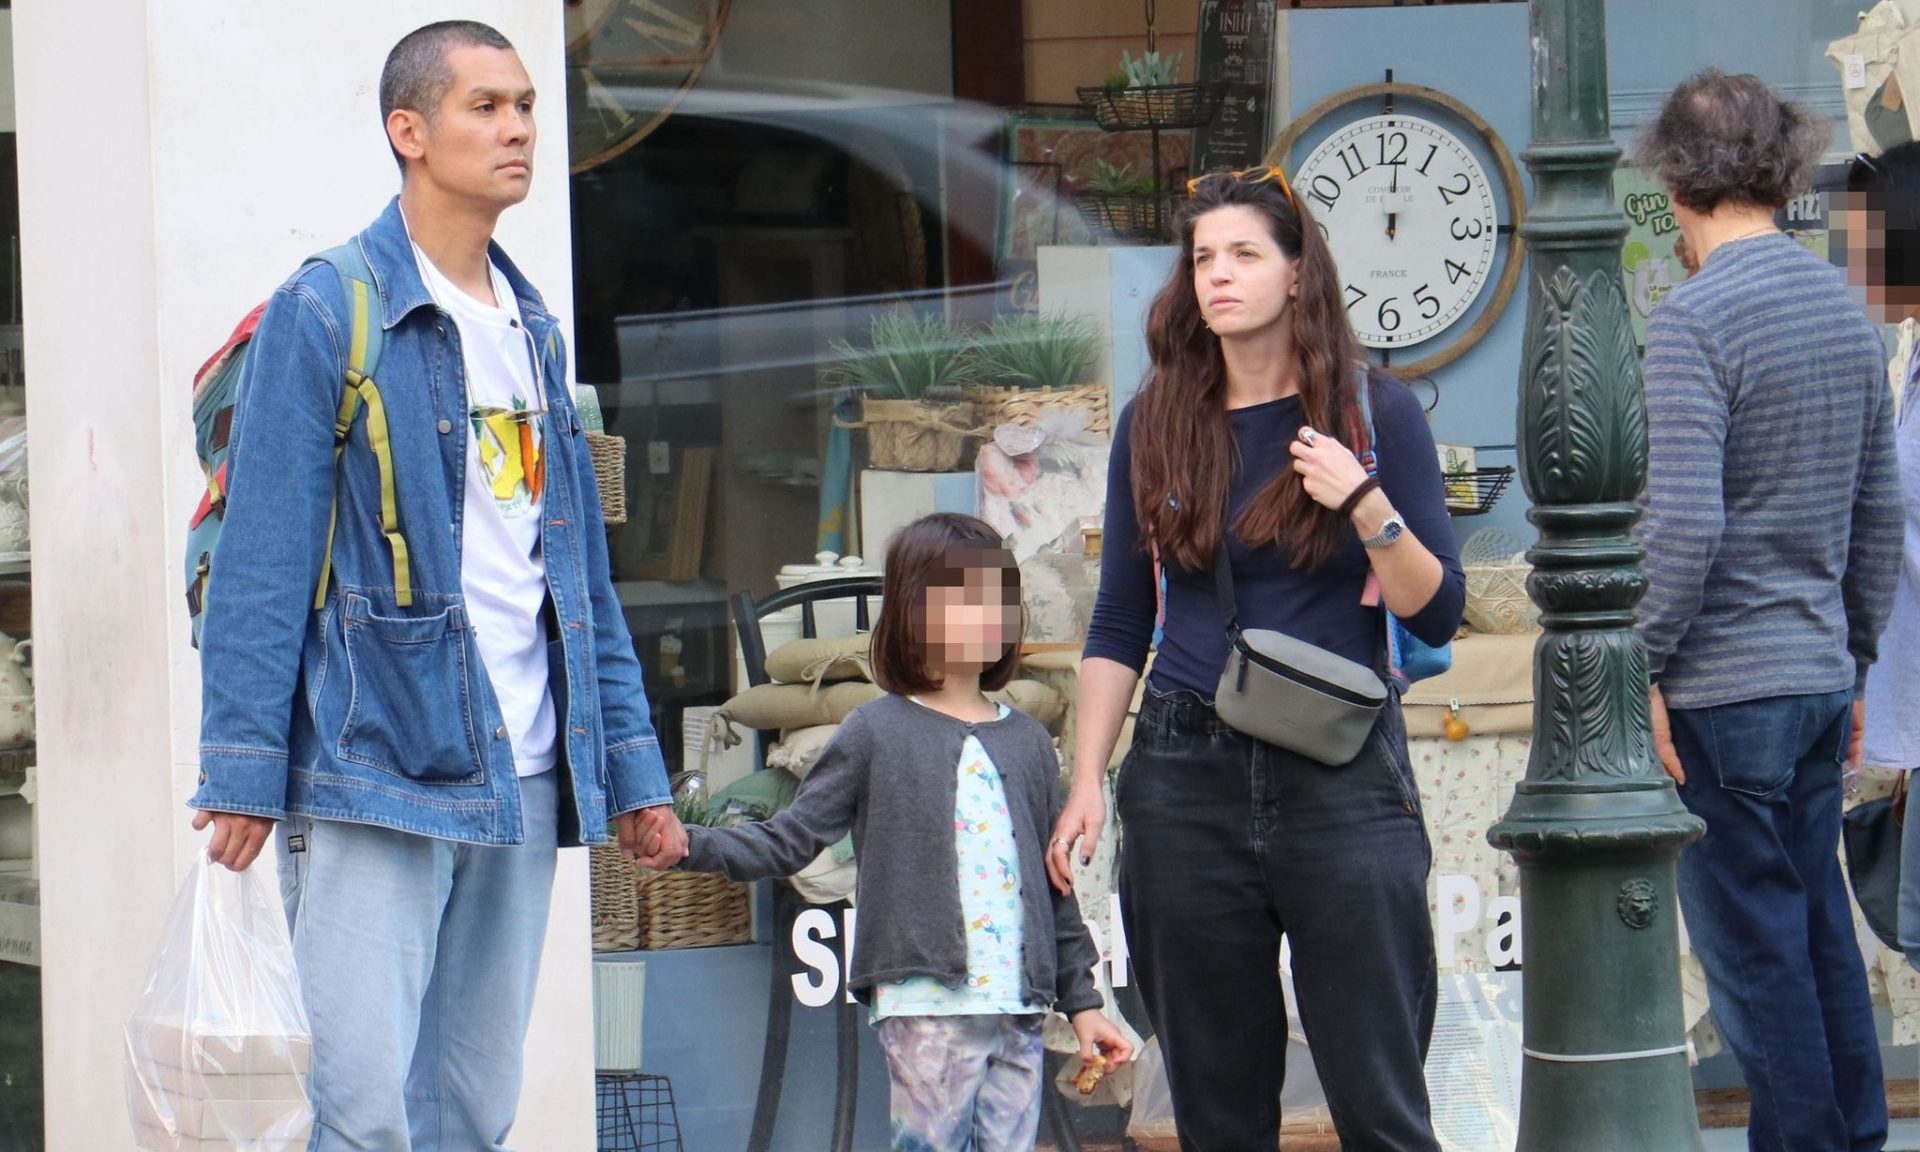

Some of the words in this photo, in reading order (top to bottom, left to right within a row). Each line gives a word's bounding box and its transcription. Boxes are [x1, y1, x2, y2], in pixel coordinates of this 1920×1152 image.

[1336, 142, 1370, 181] 11
[1376, 132, 1408, 166] 12
[1415, 144, 1439, 177] 1
[1307, 174, 1341, 213] 10
[1438, 173, 1471, 205] 2
[1626, 193, 1667, 225] Gin
[1451, 217, 1482, 241] 3
[1370, 270, 1408, 278] FRANCE
[1444, 258, 1472, 285] 4
[1378, 297, 1401, 331] 6
[1413, 283, 1441, 319] 5
